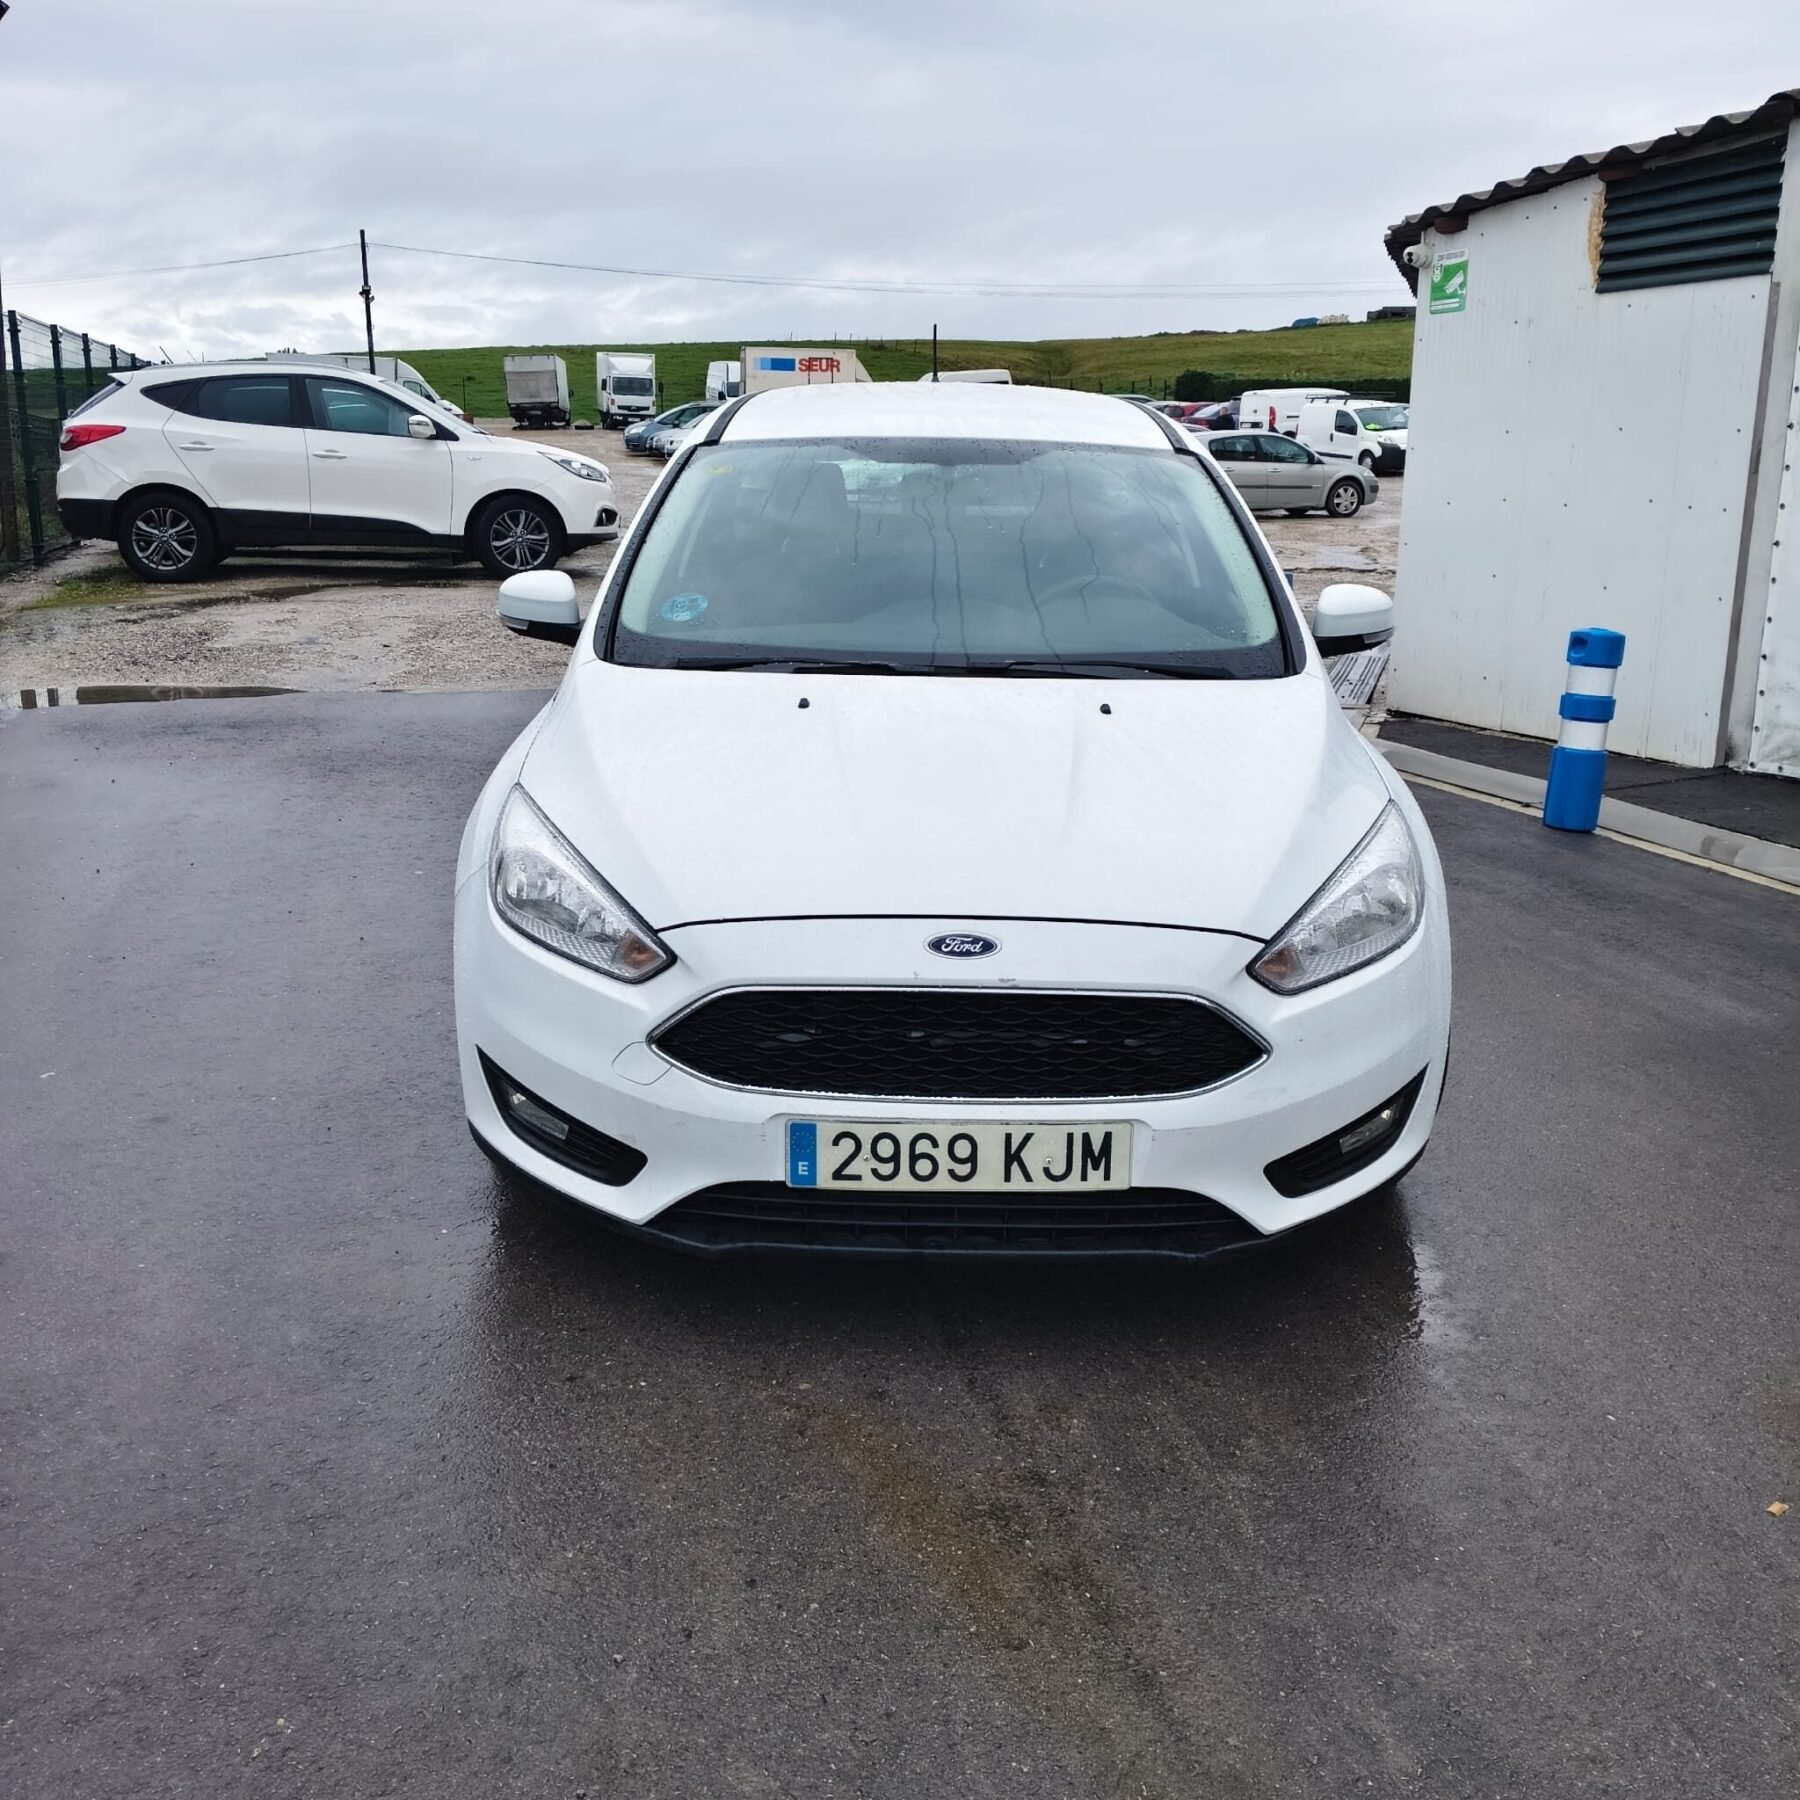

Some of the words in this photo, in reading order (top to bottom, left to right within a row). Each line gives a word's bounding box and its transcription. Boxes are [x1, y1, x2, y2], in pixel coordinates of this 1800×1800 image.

[798, 358, 841, 373] SEUR
[941, 936, 984, 952] Ford
[831, 1131, 978, 1183] 2969
[1003, 1131, 1113, 1183] KJM
[798, 1161, 809, 1176] E
